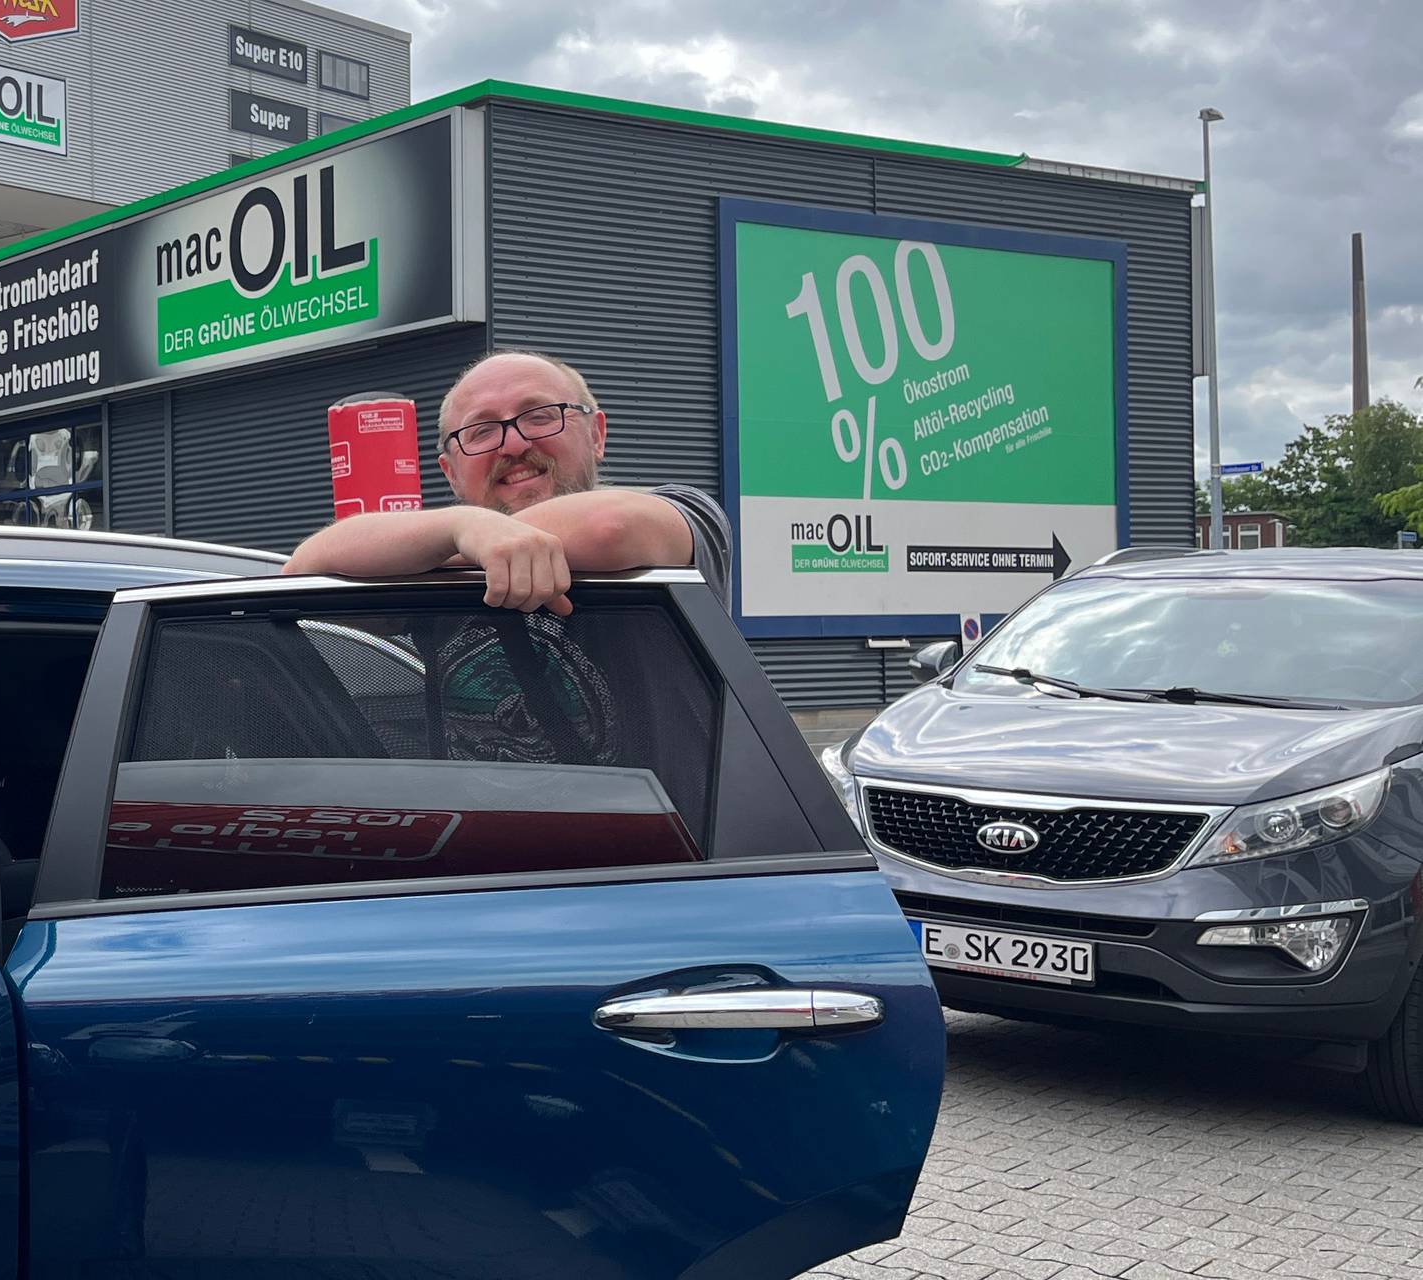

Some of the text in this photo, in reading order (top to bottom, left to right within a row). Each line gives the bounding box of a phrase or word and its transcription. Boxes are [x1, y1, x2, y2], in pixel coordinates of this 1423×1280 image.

[236, 36, 303, 71] Super E10
[10, 124, 58, 142] ÖLWECHSEL
[250, 103, 291, 131] Super
[13, 300, 99, 350] Frischöle
[164, 286, 369, 353] DER GRÜNE ÖLWECHSEL
[785, 240, 955, 402] 100
[903, 363, 970, 404] Ökostrom
[913, 383, 1015, 441] Altöl-Recycling
[831, 396, 908, 500] %
[794, 556, 886, 569] DER GRÜNE ÖLWECHSEL
[910, 552, 1054, 568] SOFORT-SERVICE OHNE TERMIN
[986, 828, 1027, 848] KIA
[925, 927, 943, 956] E
[964, 933, 1002, 964] SK
[1011, 939, 1089, 975] 2930
